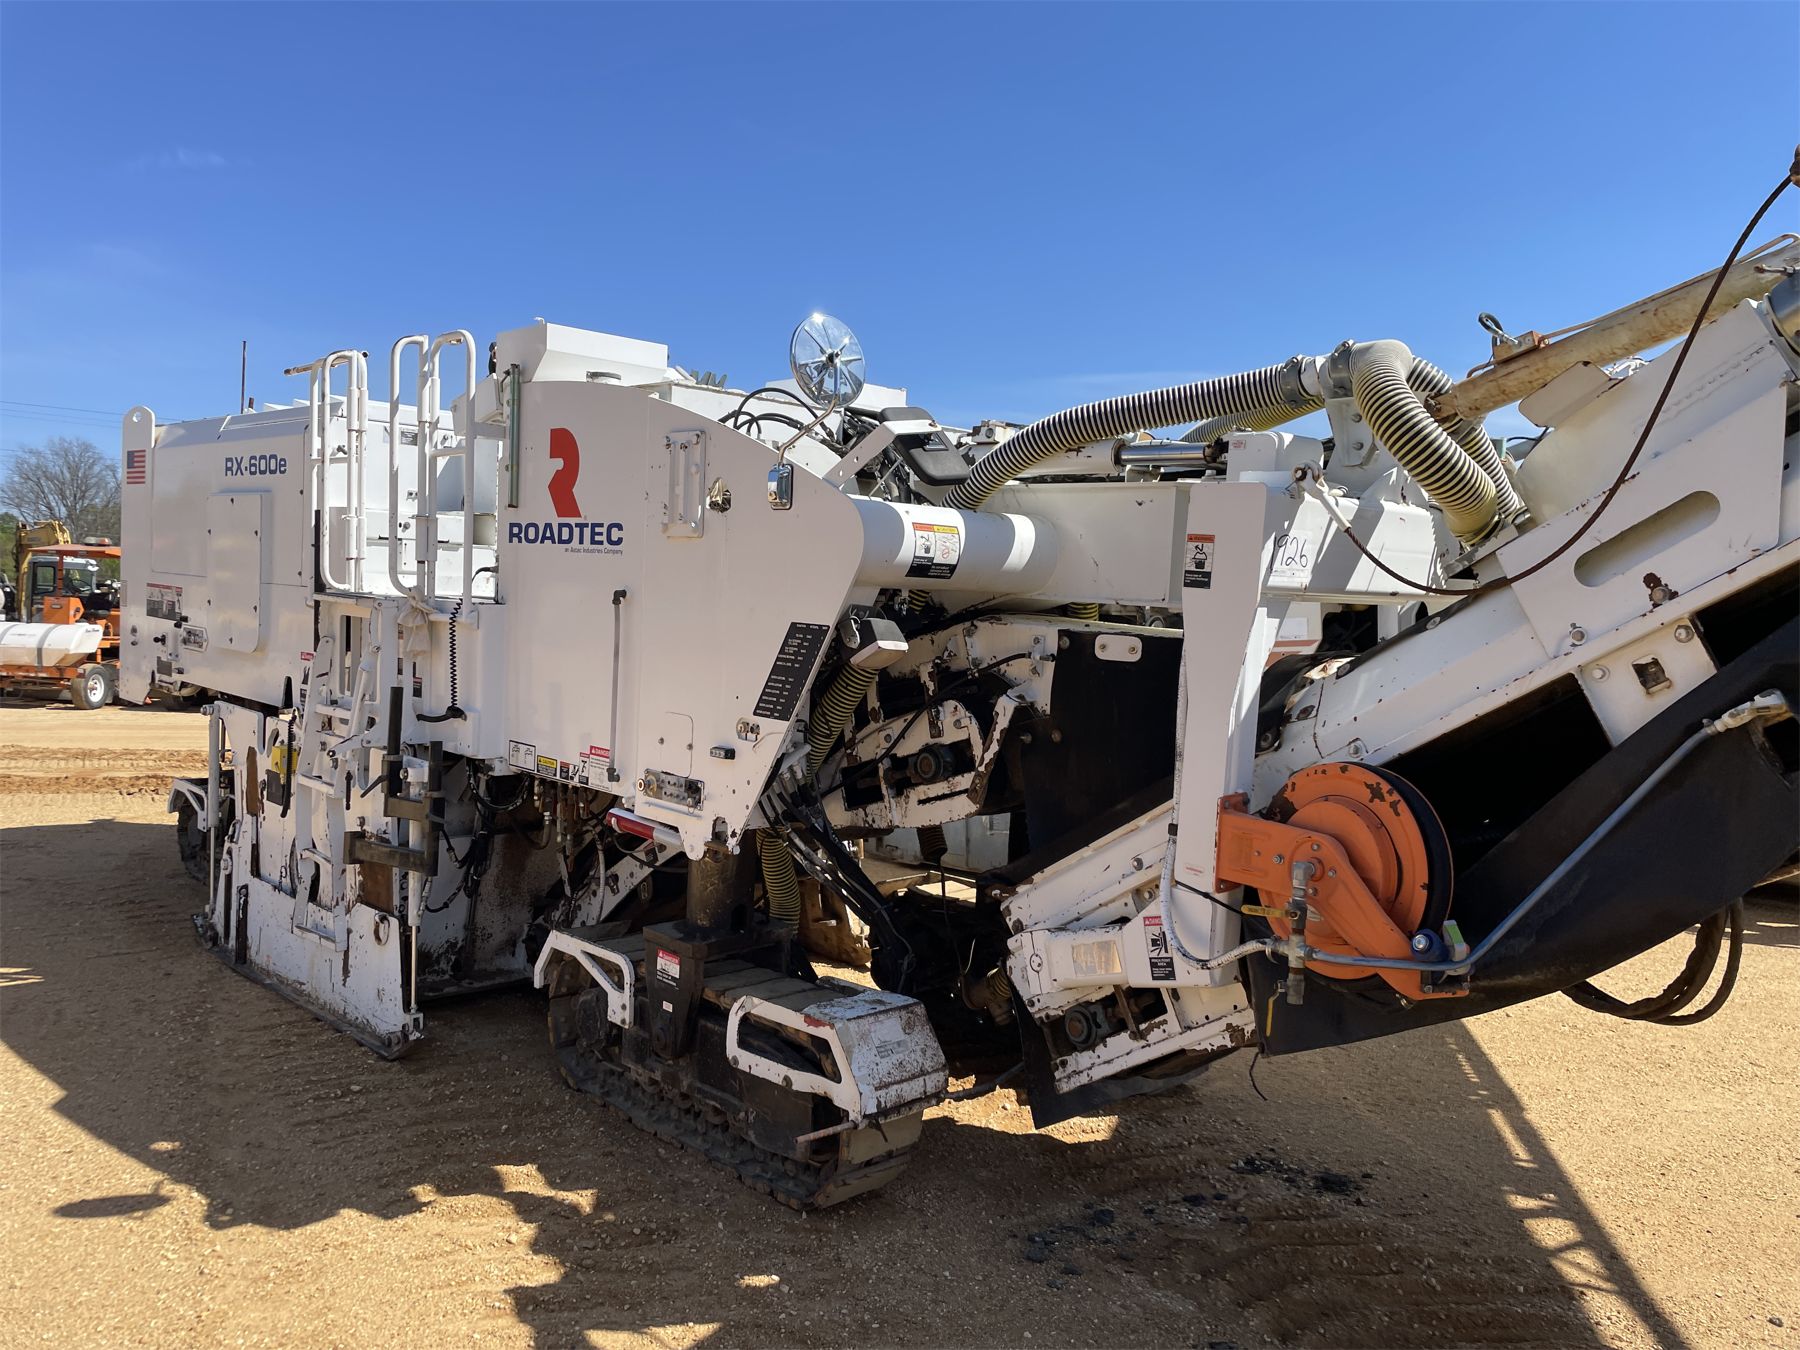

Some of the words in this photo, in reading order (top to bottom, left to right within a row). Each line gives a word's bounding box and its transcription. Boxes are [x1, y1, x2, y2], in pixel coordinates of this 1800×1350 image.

[225, 454, 287, 476] RX-600e
[508, 522, 624, 546] ROADTEC
[604, 547, 623, 556] Company
[1270, 534, 1309, 574] 1926
